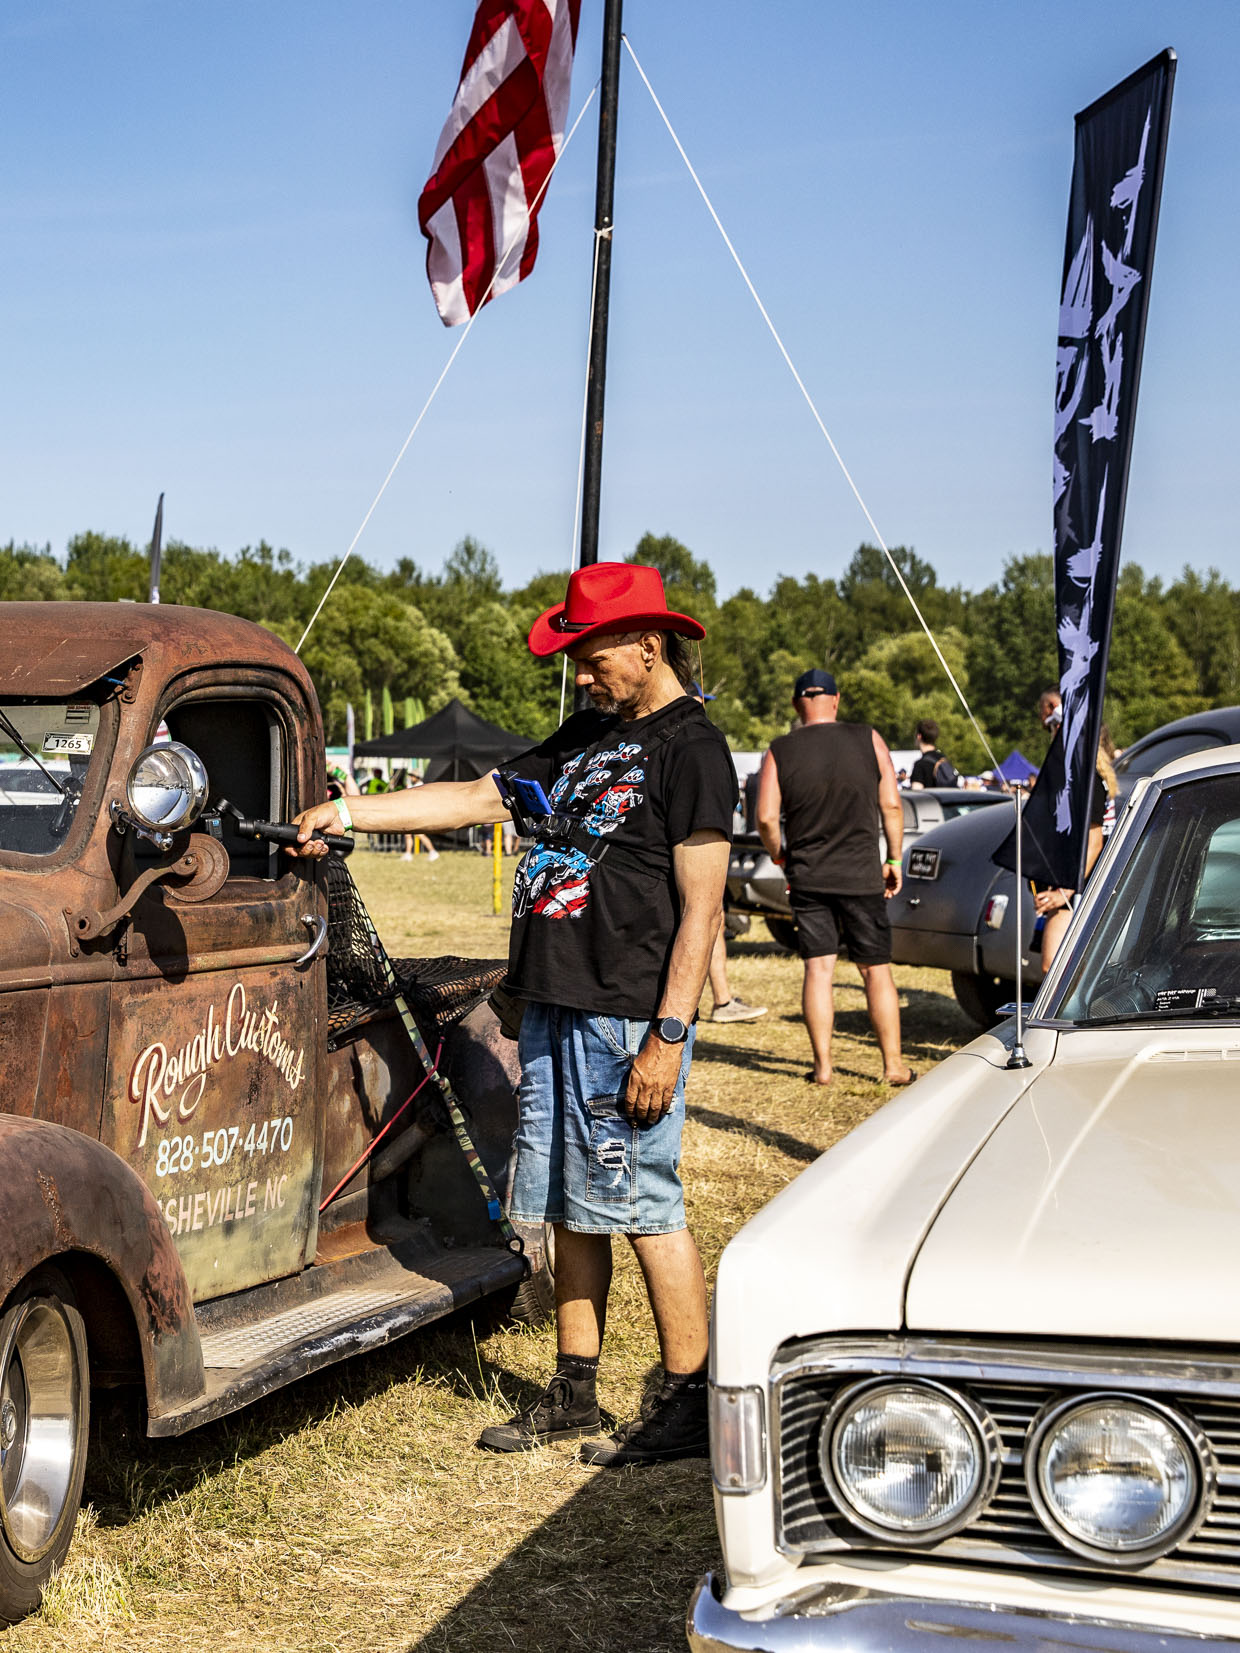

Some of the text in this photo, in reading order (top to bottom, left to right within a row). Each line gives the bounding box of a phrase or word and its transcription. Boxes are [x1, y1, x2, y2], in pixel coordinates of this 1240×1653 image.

[55, 739, 82, 749] 1265
[132, 983, 306, 1149] Rough Customs
[157, 1174, 288, 1236] SHEVILLE NC
